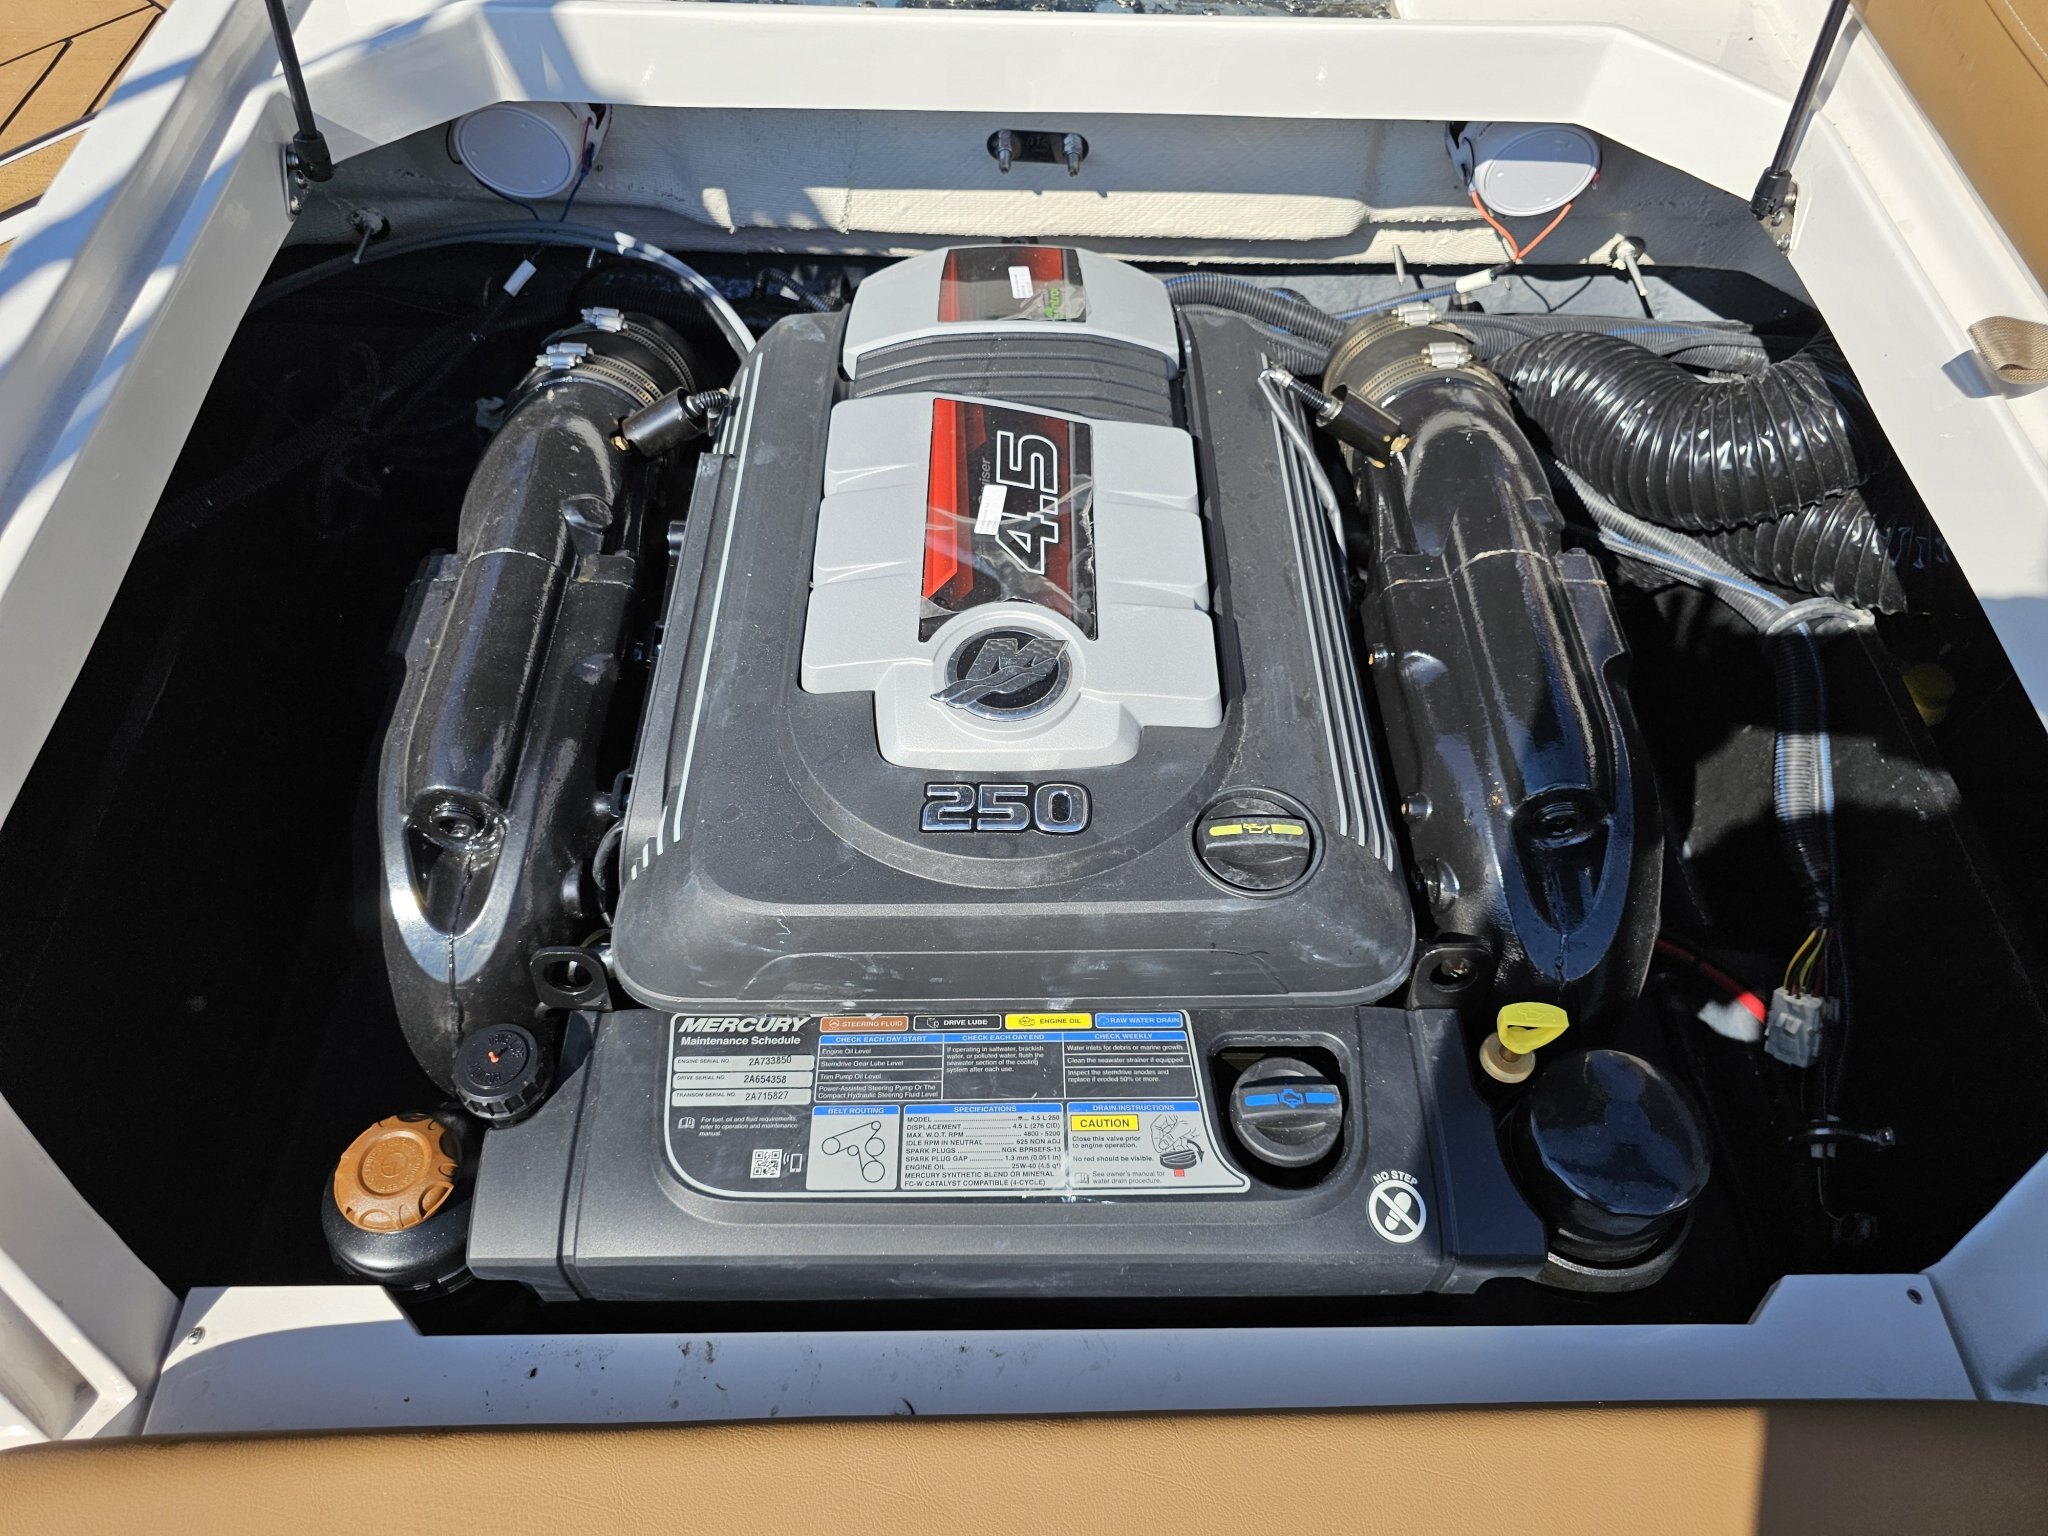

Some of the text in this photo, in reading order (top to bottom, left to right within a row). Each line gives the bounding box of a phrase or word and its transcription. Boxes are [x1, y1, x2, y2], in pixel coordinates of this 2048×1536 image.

[995, 430, 1058, 575] 4.5
[921, 782, 1091, 833] 250
[678, 1017, 810, 1032] MERCURY
[681, 1036, 800, 1045] Maintenance Schedule
[749, 1056, 792, 1066] 2A733850
[744, 1075, 786, 1083] 2A654358
[745, 1091, 788, 1100] 2A715827
[1080, 1119, 1129, 1127] CAUTION
[1373, 1170, 1418, 1185] NO STEP
